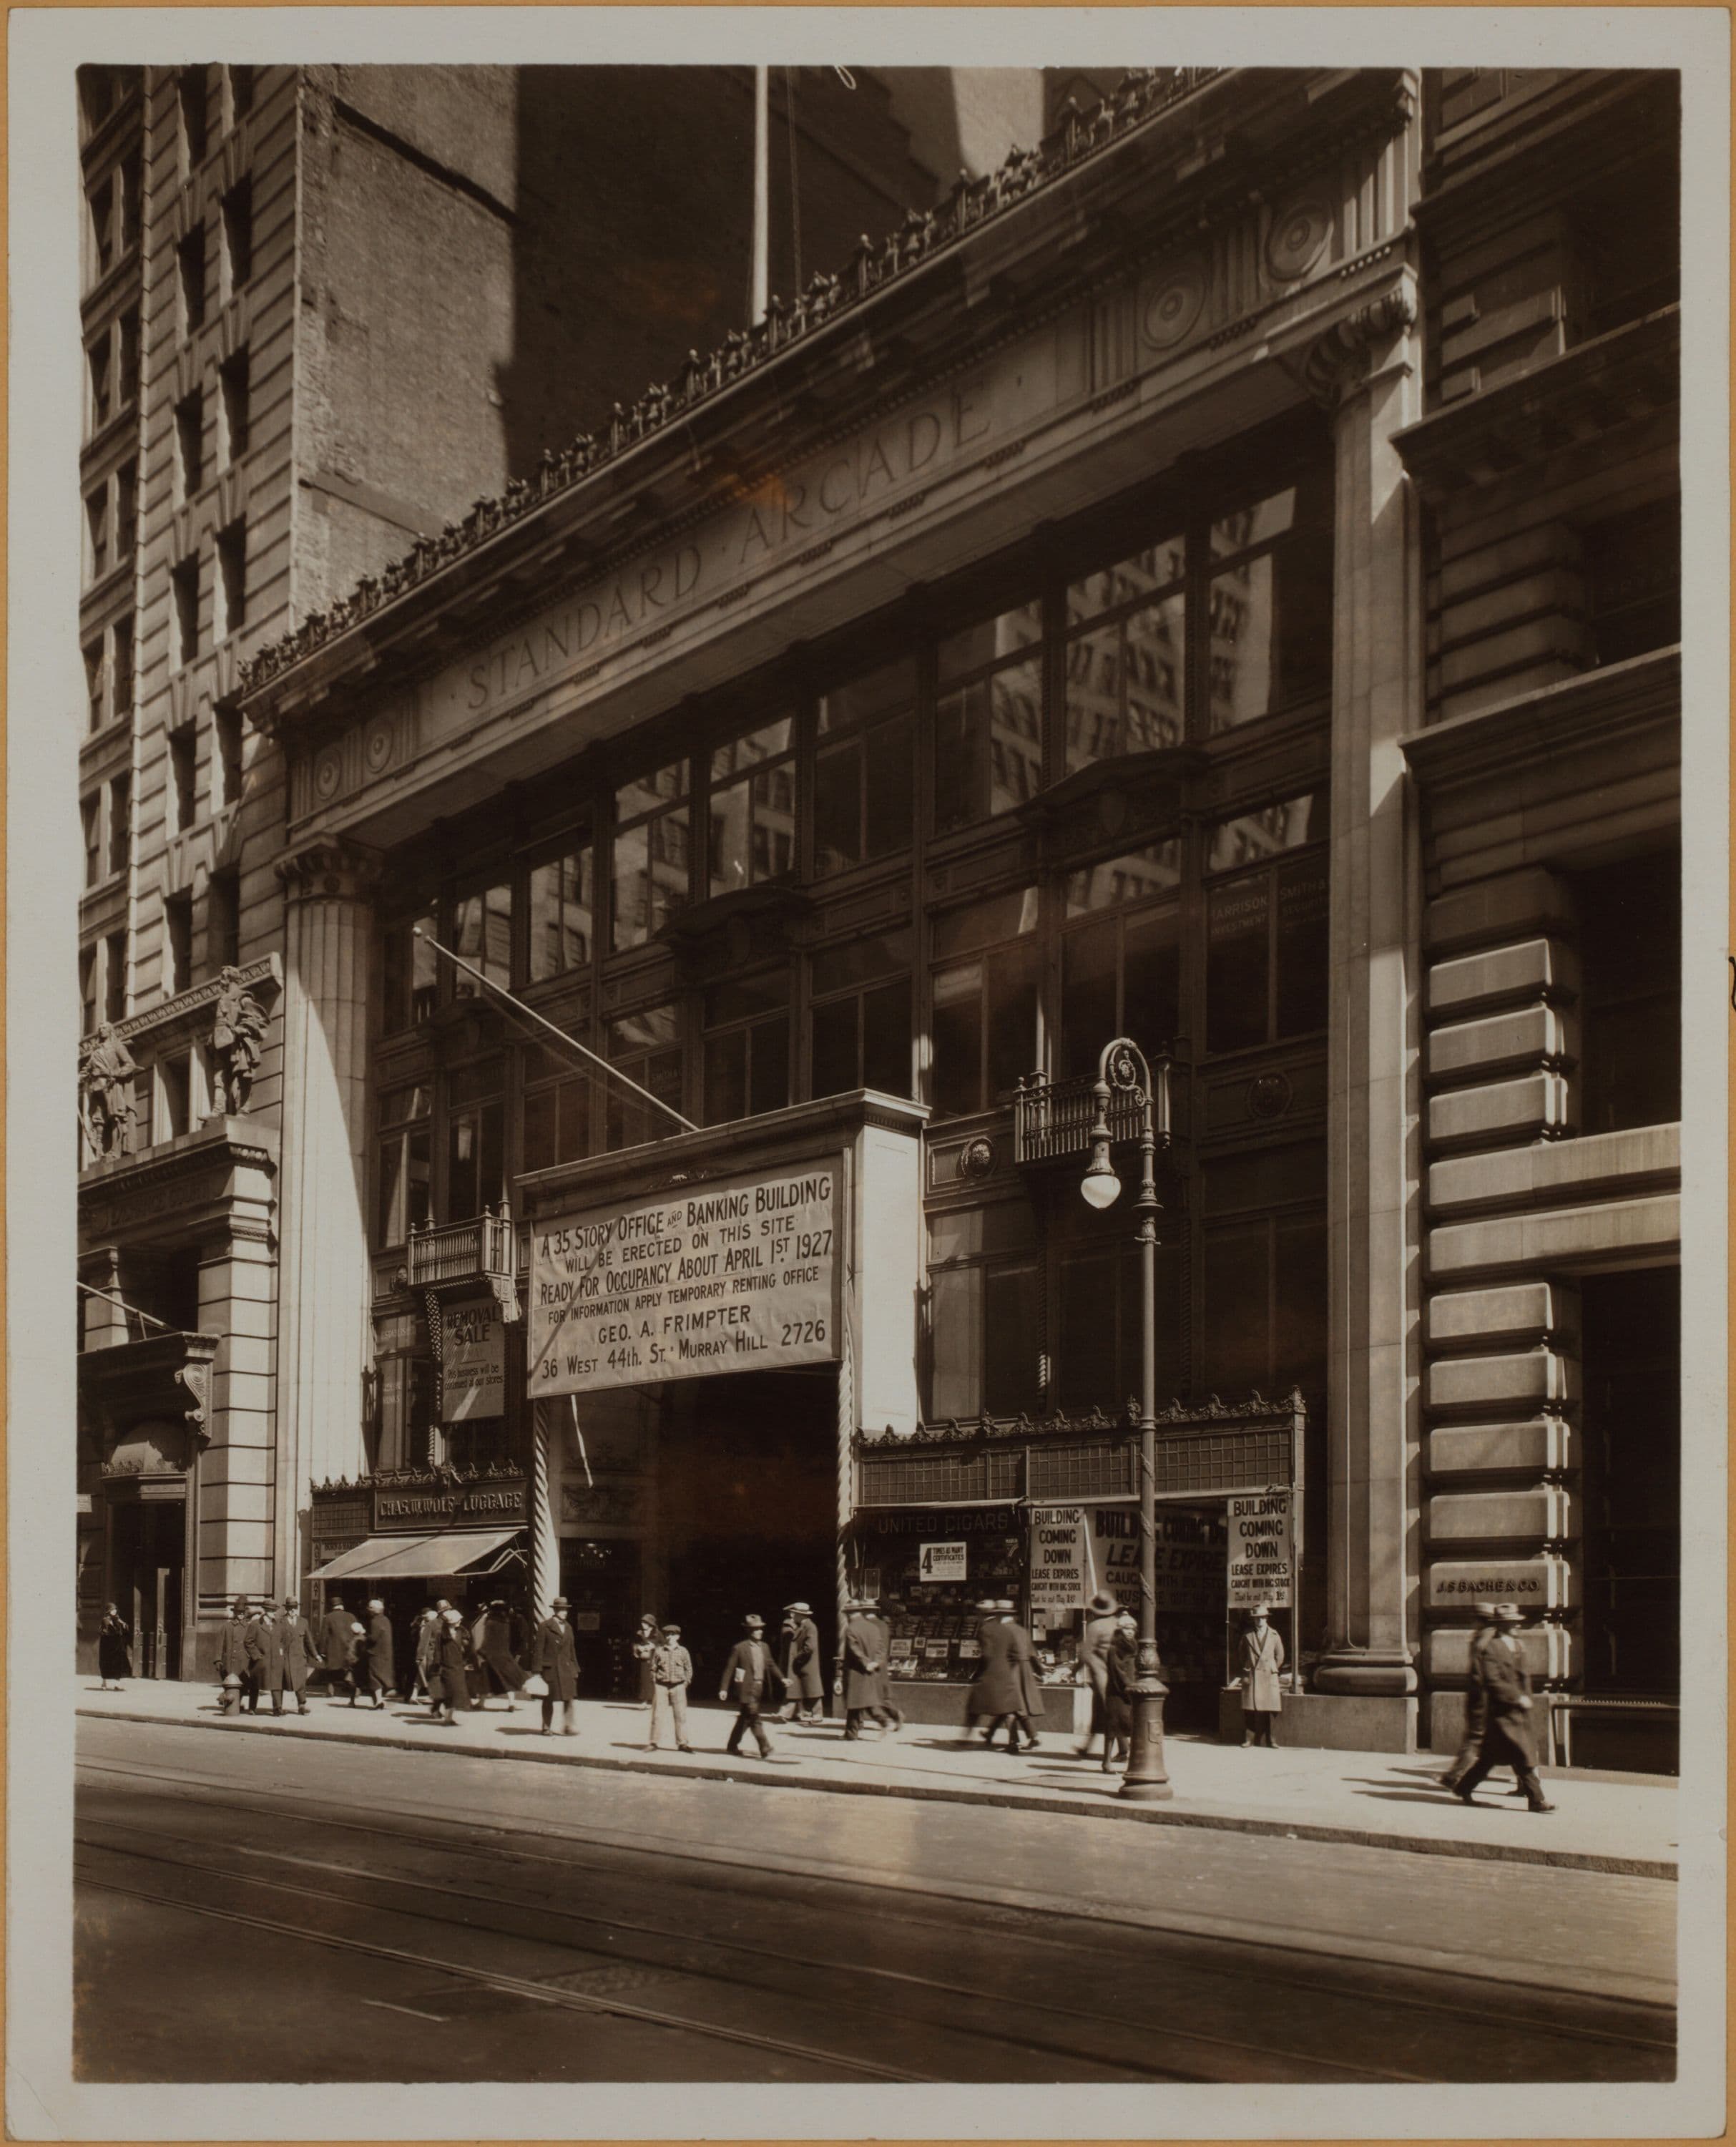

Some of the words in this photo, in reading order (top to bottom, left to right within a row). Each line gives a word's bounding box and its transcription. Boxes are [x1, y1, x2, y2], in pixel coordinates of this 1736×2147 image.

[467, 542, 702, 710] STANDARD
[740, 388, 991, 564] ARCADE
[541, 1240, 550, 1258] A
[553, 1233, 571, 1255] 35
[574, 1221, 613, 1251] STORY
[617, 1211, 665, 1241] OFFICE
[667, 1210, 683, 1228] AND
[687, 1193, 750, 1228] BANKING
[755, 1175, 832, 1215] BUILDING
[565, 1258, 591, 1275] WILL
[598, 1250, 613, 1268] BE
[622, 1238, 682, 1263] ERECTED
[692, 1231, 710, 1249] ON
[720, 1223, 751, 1245] THIS
[760, 1215, 795, 1238] SITE
[541, 1279, 574, 1306] READY
[579, 1276, 599, 1300] FOR
[606, 1262, 672, 1293] OCCUPANCY
[677, 1253, 719, 1281] ABOUT
[724, 1246, 763, 1273] APRIL
[795, 1229, 833, 1261] 1927
[548, 1308, 567, 1325] FOR
[571, 1298, 629, 1321] INFORMATION
[635, 1291, 662, 1313] APPLY
[667, 1280, 727, 1306] TEMPORARY
[732, 1271, 777, 1294] RENTING
[783, 1265, 820, 1287] OFFICE
[446, 1304, 500, 1329] REMOVAL
[598, 1323, 632, 1345] GEO.
[640, 1321, 654, 1339] A.
[663, 1304, 751, 1335] FRIMPTER
[455, 1323, 491, 1346] SALE
[541, 1359, 559, 1380] 36
[567, 1355, 599, 1376] WEST
[678, 1338, 728, 1360] MURRAY
[735, 1329, 769, 1353] HILL
[780, 1319, 826, 1347] 2726
[491, 1363, 499, 1374] be
[464, 1492, 522, 1511] LUGGAGE
[1234, 1498, 1287, 1517] BUILDING
[878, 1515, 937, 1535] UNITED
[944, 1512, 1009, 1532] CIGARS
[1034, 1510, 1079, 1525] BUILDING
[1039, 1529, 1077, 1544] COMING
[1240, 1520, 1283, 1537] COMING
[1044, 1548, 1071, 1564] DOWN
[1106, 1543, 1166, 1569] LEAE
[1245, 1540, 1278, 1559] DOWN
[921, 1547, 933, 1574] 4
[1232, 1564, 1254, 1575] LEASE
[1256, 1562, 1288, 1575] EXPIRES
[1031, 1568, 1051, 1580] LEASE
[1052, 1568, 1079, 1580] EXPIRES
[1106, 1570, 1142, 1585] CAUG
[1457, 1579, 1503, 1593] BACHE
[1115, 1589, 1142, 1603] MUS
